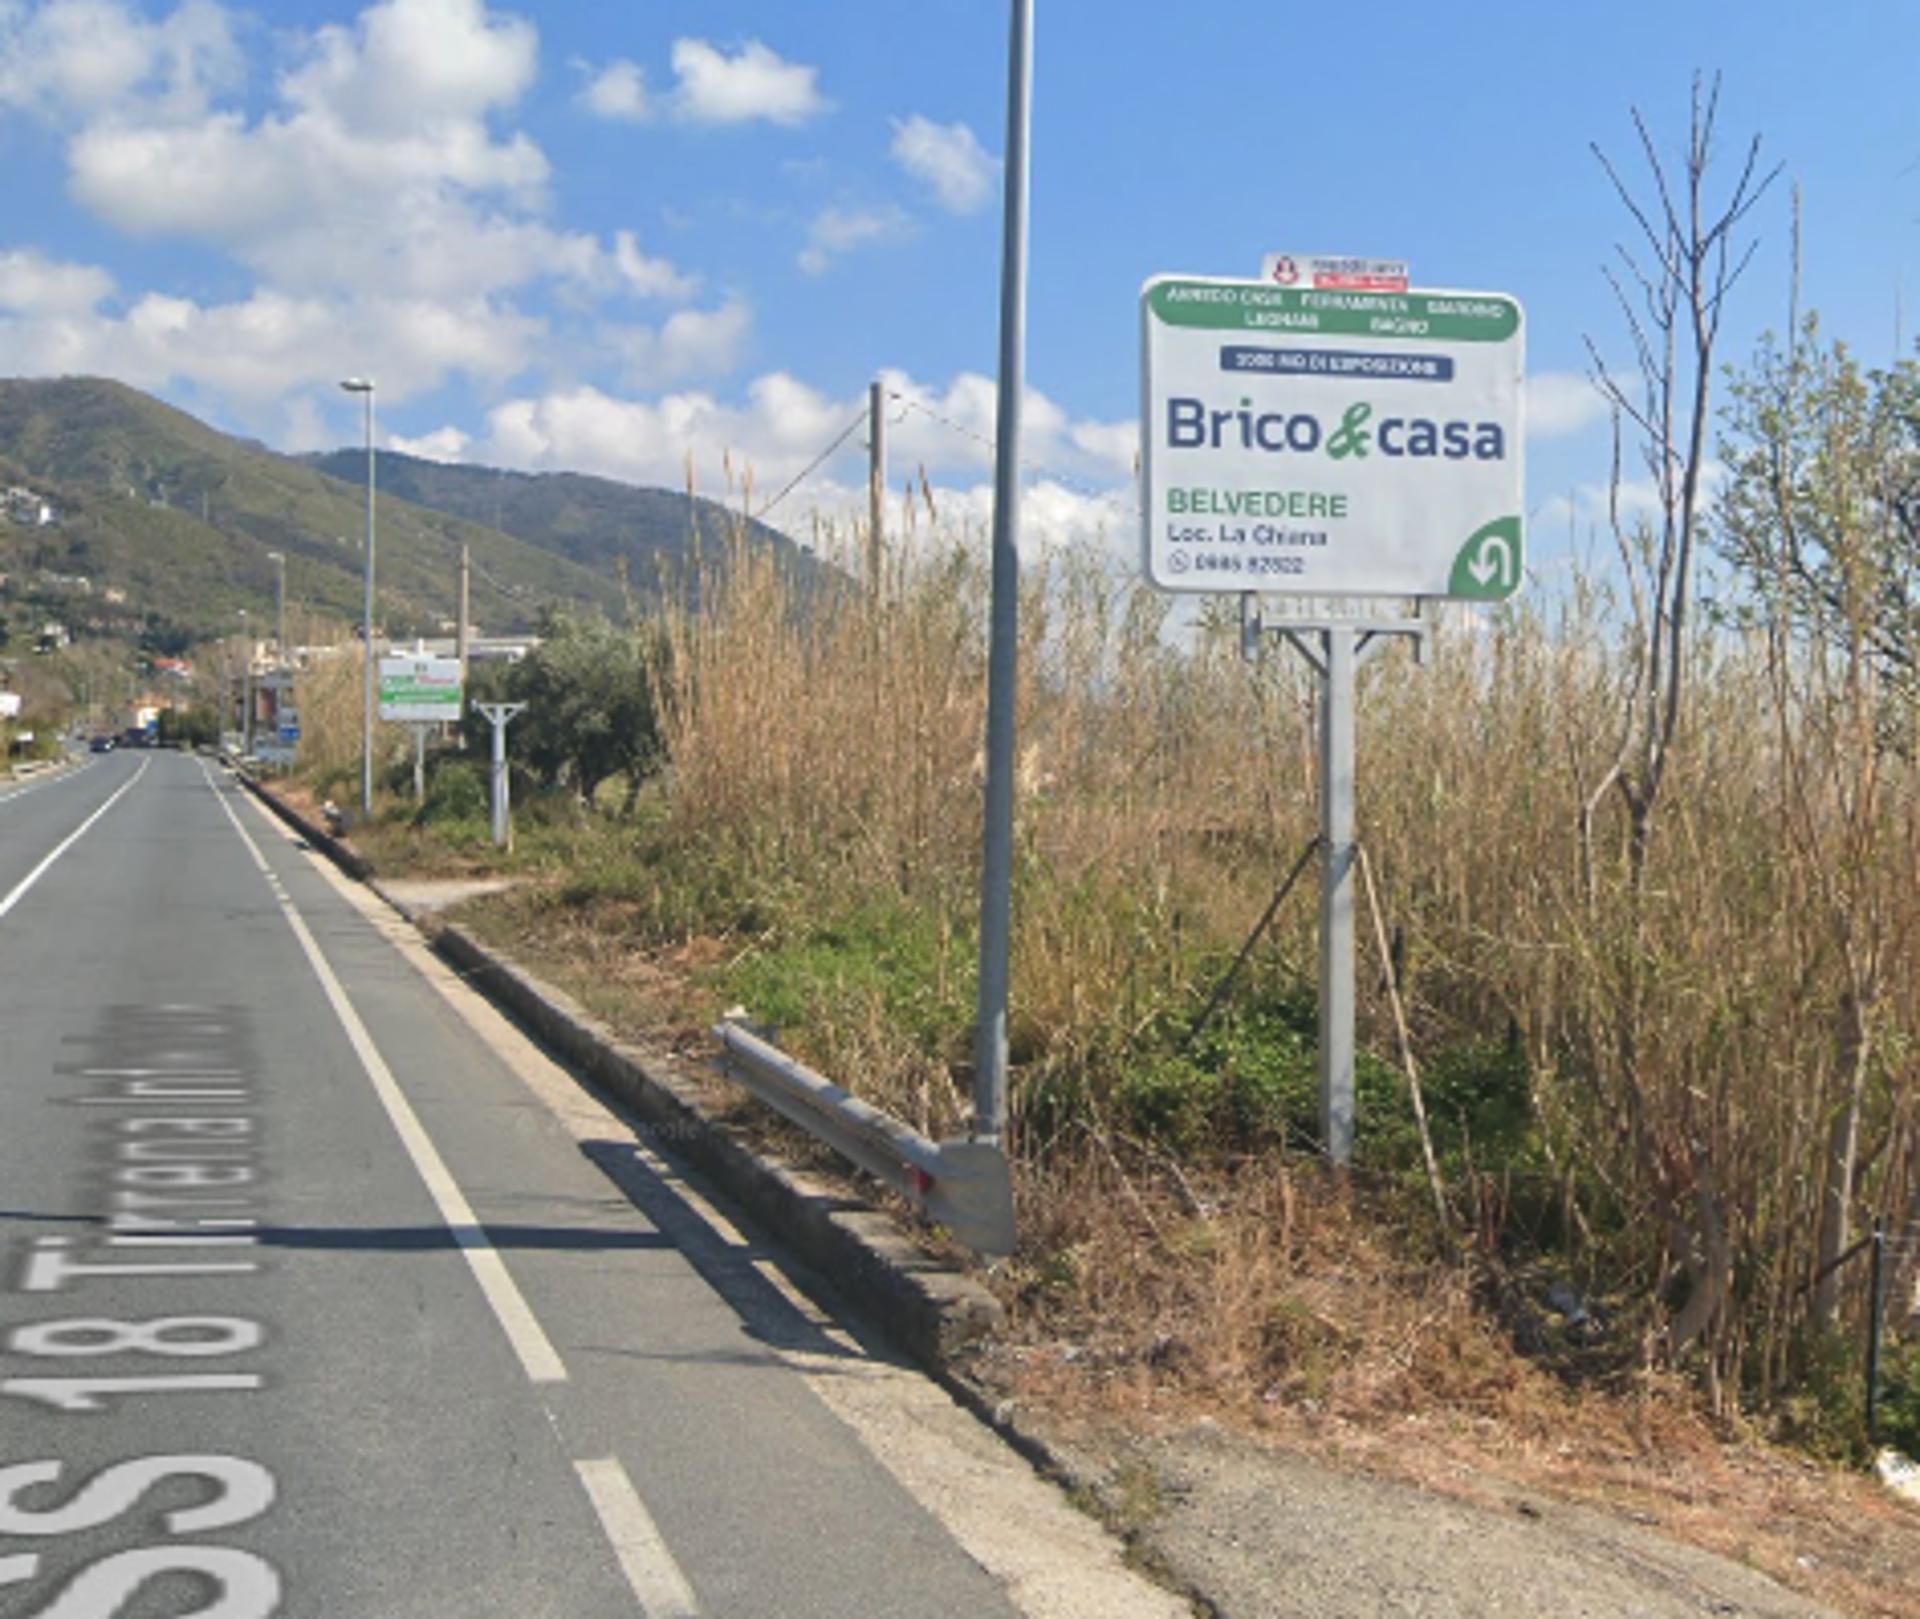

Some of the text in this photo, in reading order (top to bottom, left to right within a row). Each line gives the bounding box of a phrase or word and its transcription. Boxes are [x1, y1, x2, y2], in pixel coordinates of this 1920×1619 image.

[1167, 487, 1348, 519] BELVEDERE
[1167, 524, 1213, 543] Loc.
[1220, 524, 1246, 544] La
